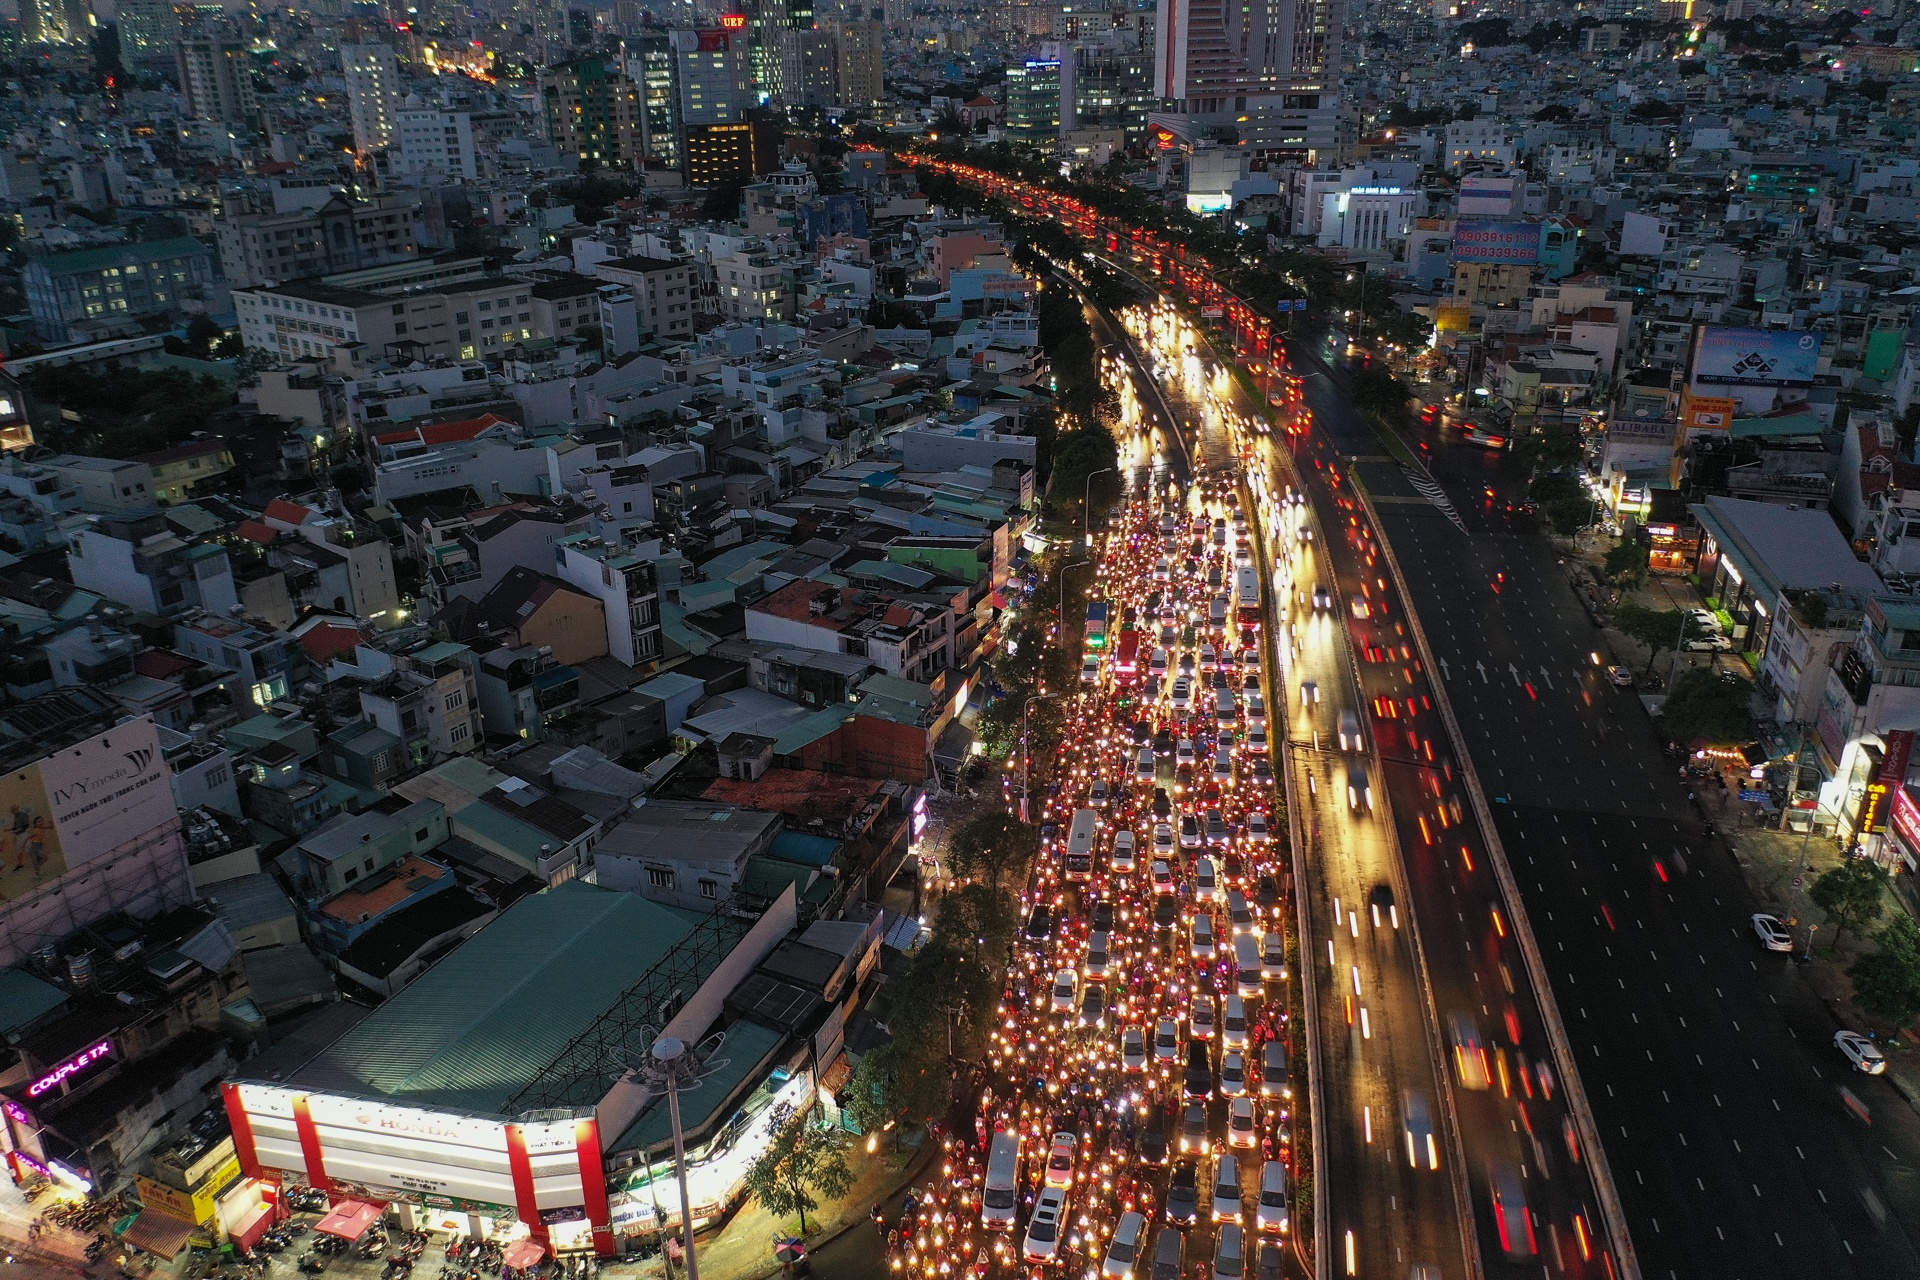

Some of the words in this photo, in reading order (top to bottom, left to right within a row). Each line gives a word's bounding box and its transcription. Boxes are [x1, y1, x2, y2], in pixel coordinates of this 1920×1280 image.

[723, 16, 745, 27] UEF
[1458, 230, 1538, 244] 0903916112
[1456, 246, 1536, 259] 0908339366
[1612, 423, 1665, 434] ALIBABA
[54, 777, 89, 805] IVY
[91, 769, 128, 790] moda
[30, 1055, 89, 1095] COUPLE
[89, 1042, 109, 1058] TX
[380, 1118, 459, 1139] HONDA
